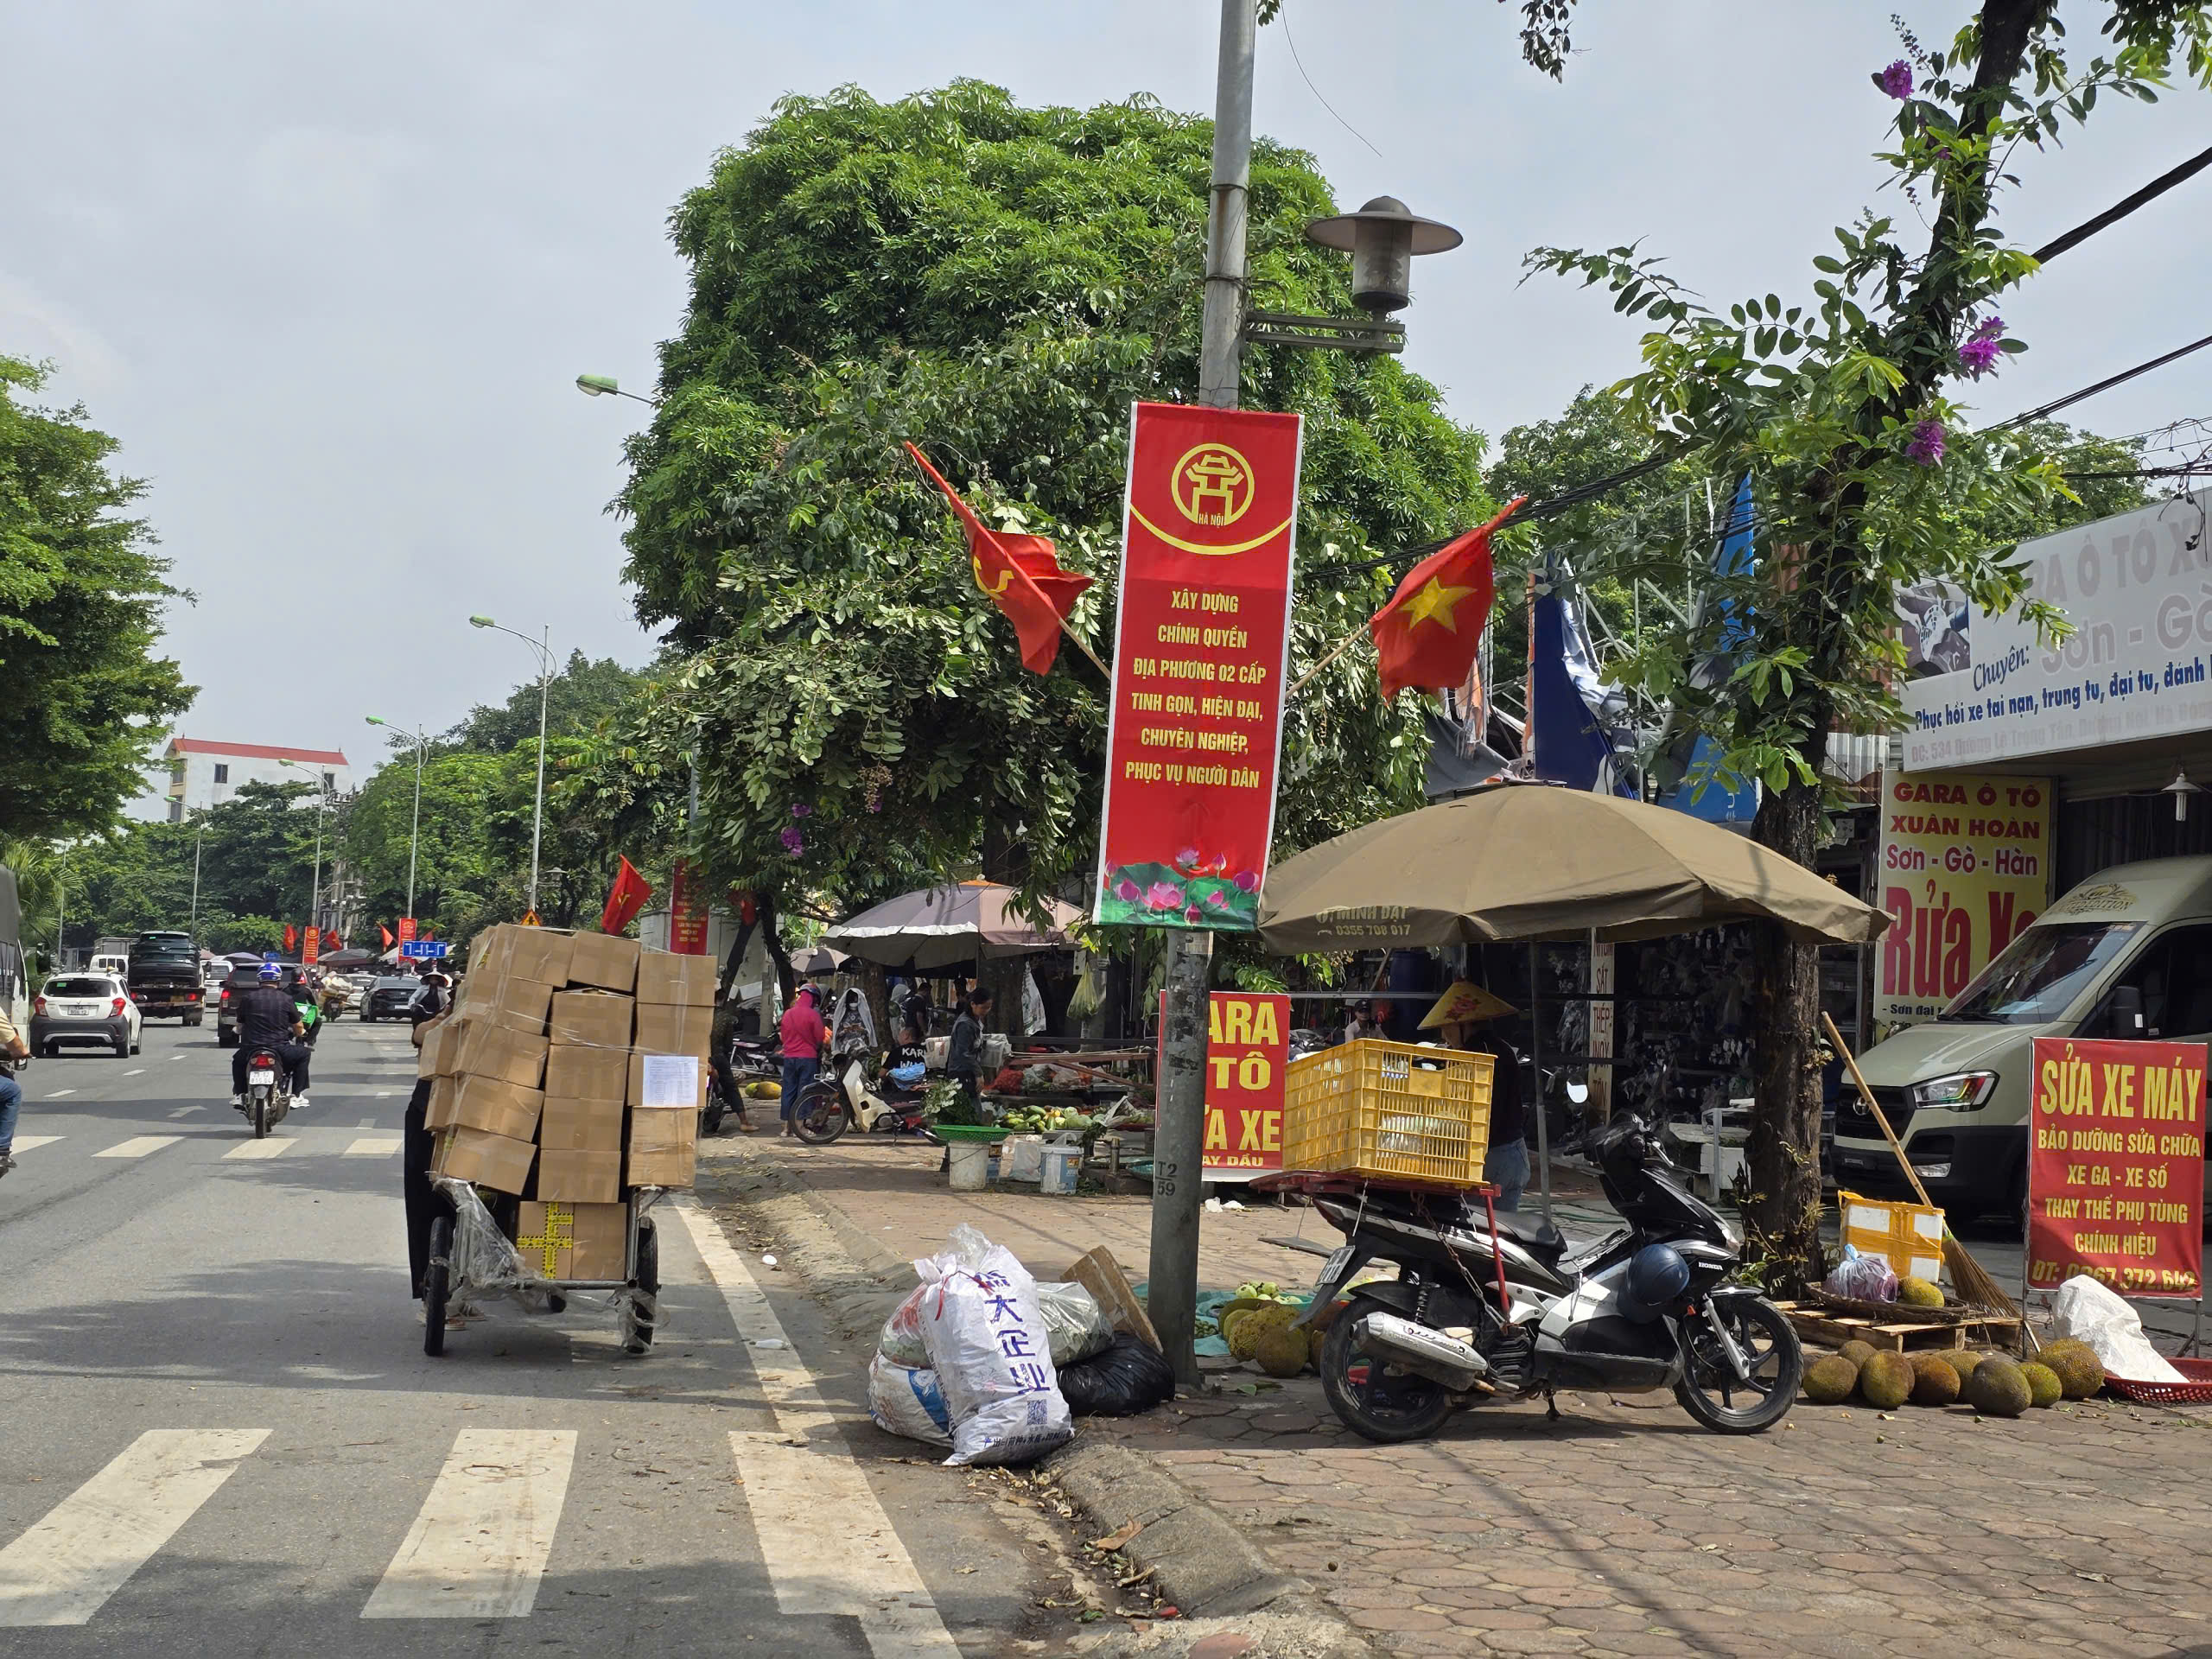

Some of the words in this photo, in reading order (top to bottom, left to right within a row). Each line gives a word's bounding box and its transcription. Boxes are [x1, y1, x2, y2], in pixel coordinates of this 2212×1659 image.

[1198, 512, 1209, 525] HÀ
[1211, 513, 1224, 529] NỘI
[2077, 534, 2100, 597] Ô
[2113, 518, 2157, 588] TÔ
[1172, 588, 1197, 609] XÂY
[1202, 592, 1238, 614] DỰNG
[1158, 623, 1199, 645] CHÍNH
[1203, 626, 1247, 648] QUYỀN
[1134, 658, 1156, 679] ĐỊA
[1160, 658, 1214, 681] PHƯƠNG
[1218, 666, 1235, 682] 02
[1239, 661, 1266, 684] CẤP
[1974, 645, 2030, 691] Chuyên:
[1132, 693, 1161, 711] TINH
[1166, 696, 1197, 716] GỌN,
[1202, 698, 1232, 720] HIỆN
[1236, 701, 1263, 721] ĐẠI,
[1916, 710, 1942, 735] Phục
[1946, 702, 1964, 726] hồi
[1968, 706, 1983, 722] xe
[1987, 697, 2004, 718] tai
[2009, 693, 2038, 719] nạn,
[2043, 686, 2081, 709] trung
[2086, 680, 2104, 703] tu,
[2109, 672, 2133, 701] đại
[2138, 670, 2158, 694] tu,
[2164, 657, 2204, 689] đánh
[1141, 728, 1194, 749] CHUYÊN
[1198, 732, 1249, 754] NGHIỆP,
[1126, 762, 1161, 785] PHỤC
[1166, 765, 1183, 785] VỤ
[1187, 764, 1227, 787] NGƯỜI
[1231, 767, 1259, 789] DÂN
[1893, 782, 1967, 804] GARA
[1976, 783, 1997, 806] Ô
[2006, 785, 2041, 808] TÔ
[1891, 813, 1959, 836] XUÂN
[1969, 816, 2039, 839] HOÀN
[1886, 843, 1925, 871] Sơn
[1945, 846, 1976, 874] Gò
[1995, 847, 2037, 875] Hàn
[1337, 906, 1376, 920] MINH
[1381, 906, 1409, 922] ĐẠT
[1336, 925, 1364, 936] 0355
[1391, 925, 1410, 936] 017
[1883, 879, 1971, 999] Rửa
[1890, 1004, 1912, 1014] Sơn
[1208, 1001, 1280, 1046] ARA
[1210, 1052, 1271, 1090] TÔ
[2040, 1042, 2094, 1116] SỬA
[2101, 1064, 2135, 1118] XE
[2143, 1056, 2201, 1122] MÁY
[1238, 1109, 1281, 1152] XE
[2038, 1123, 2068, 1150] BẢO
[2072, 1128, 2123, 1153] DƯỠNG
[2127, 1128, 2156, 1154] SỬA
[2160, 1133, 2201, 1157] CHỮA
[1159, 1161, 1177, 1177] T2
[2067, 1165, 2086, 1185] XE
[2090, 1166, 2111, 1186] GA
[2125, 1167, 2143, 1187] XE
[2147, 1162, 2168, 1189] SỐ
[1158, 1181, 1175, 1196] 59
[2045, 1198, 2080, 1218] THAY
[2084, 1194, 2113, 1220] THẾ
[2116, 1200, 2145, 1225] PHỤ
[2149, 1198, 2188, 1224] TÙNG
[2075, 1230, 2119, 1254] CHÍNH
[2123, 1232, 2156, 1260] HIỆU
[1698, 1262, 1723, 1271] HONDA
